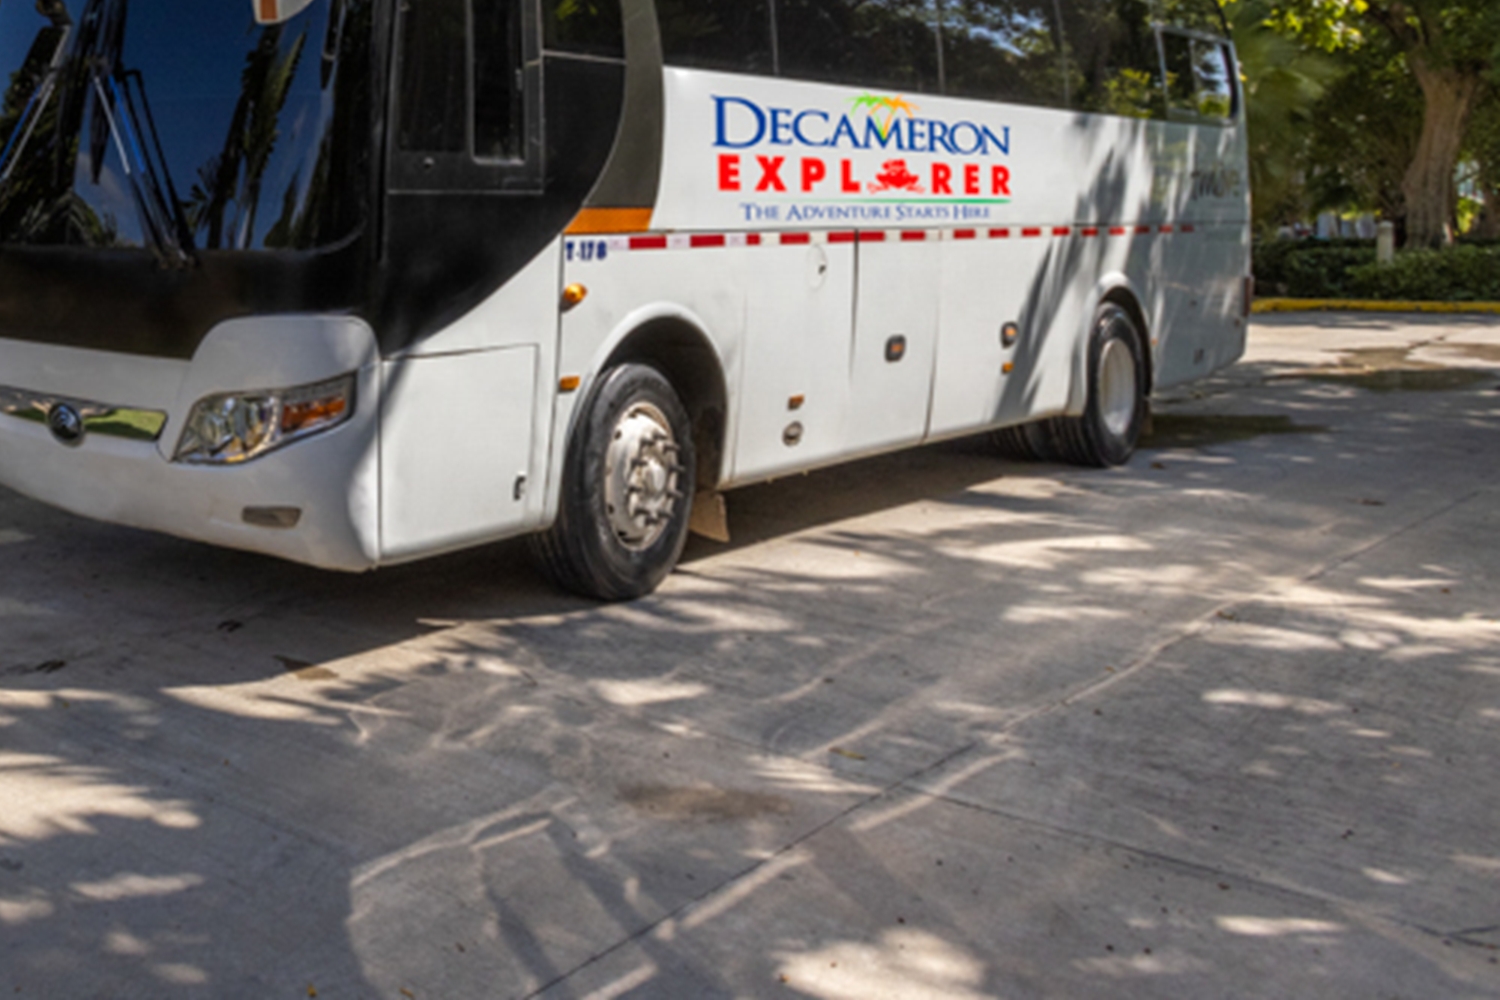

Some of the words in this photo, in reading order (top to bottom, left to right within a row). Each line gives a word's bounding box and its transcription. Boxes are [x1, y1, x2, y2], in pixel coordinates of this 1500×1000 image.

[710, 94, 1010, 156] DECAMERON
[717, 153, 1012, 196] EXPLRER
[739, 202, 779, 221] THE
[786, 203, 890, 222] ADVENTURE
[895, 203, 949, 221] STARTS
